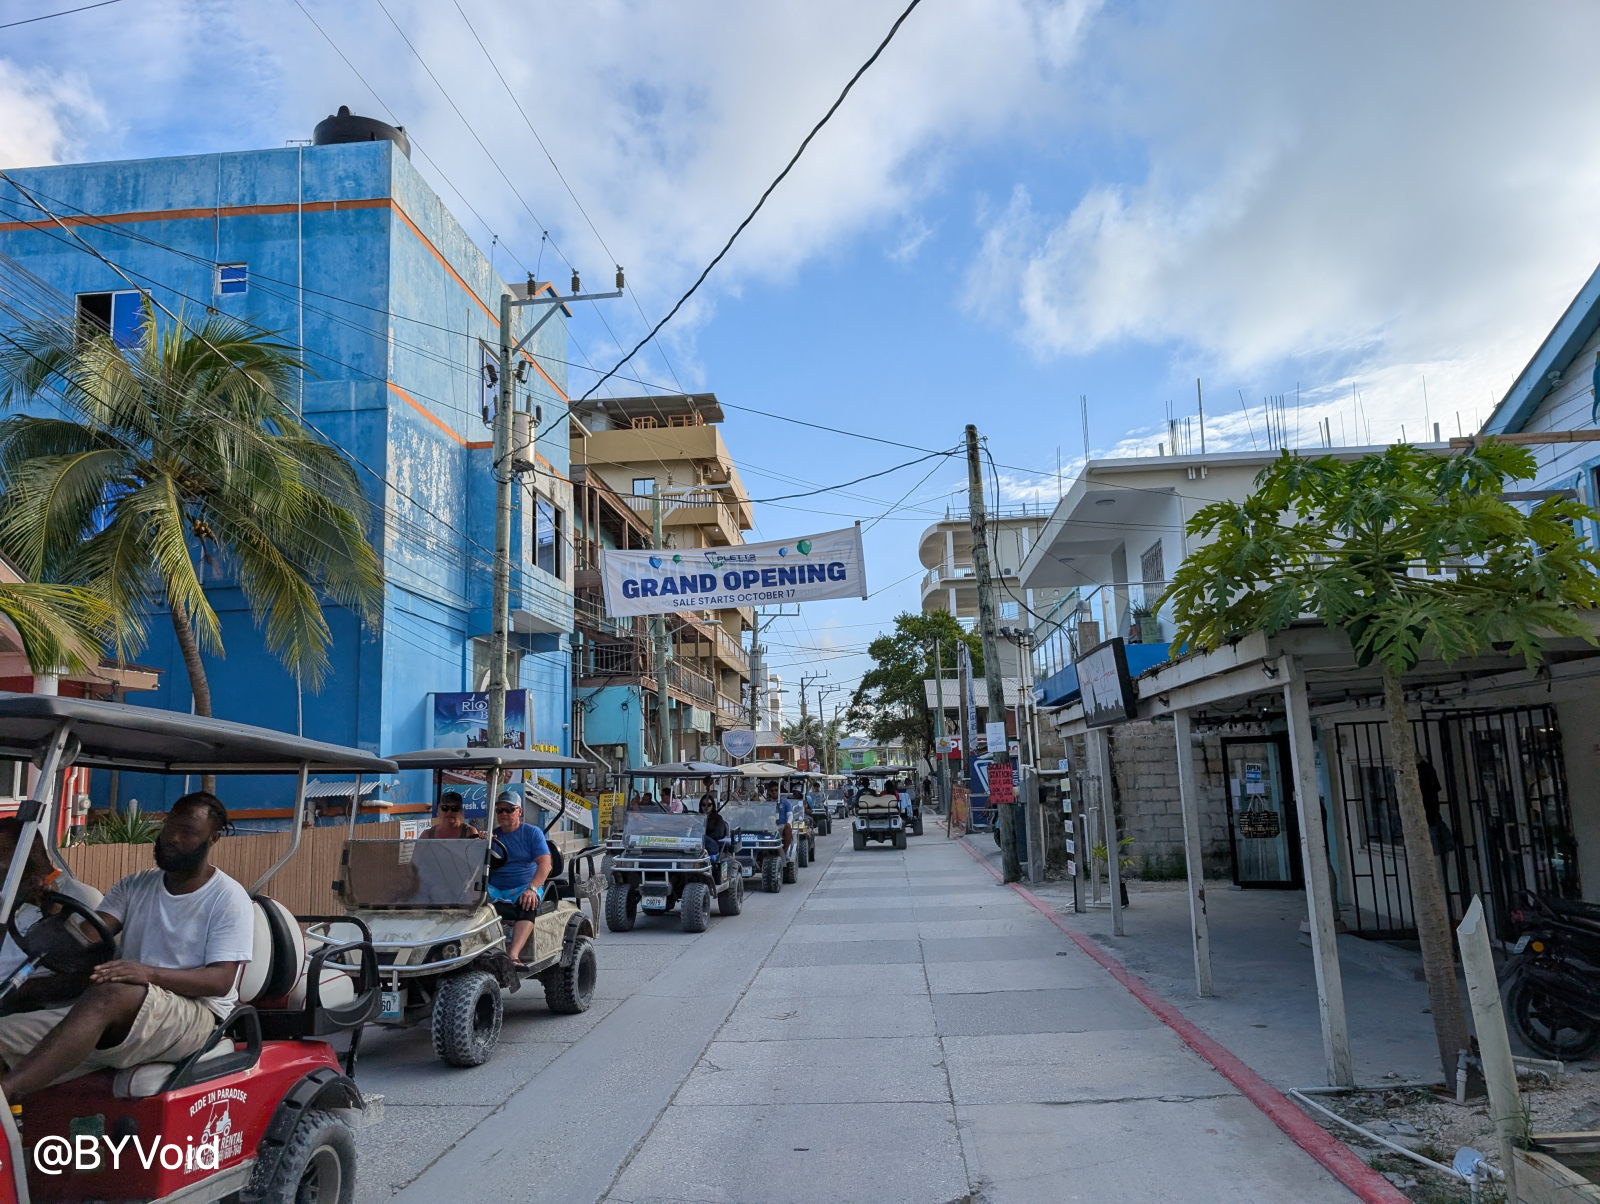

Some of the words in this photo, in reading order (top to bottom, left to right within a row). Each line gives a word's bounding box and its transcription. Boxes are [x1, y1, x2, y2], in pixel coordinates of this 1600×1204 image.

[622, 573, 717, 599] GRAND
[723, 561, 847, 591] OPENING
[673, 597, 696, 607] SALE
[698, 594, 735, 605] STARTS
[737, 591, 785, 602] OCTOBER
[786, 589, 796, 598] 17
[564, 791, 575, 801] LUE
[462, 801, 479, 810] resh.
[189, 1096, 207, 1117] RIDE
[208, 1091, 216, 1104] IN
[217, 1088, 248, 1104] PARADISE
[220, 1131, 243, 1149] RENTAL
